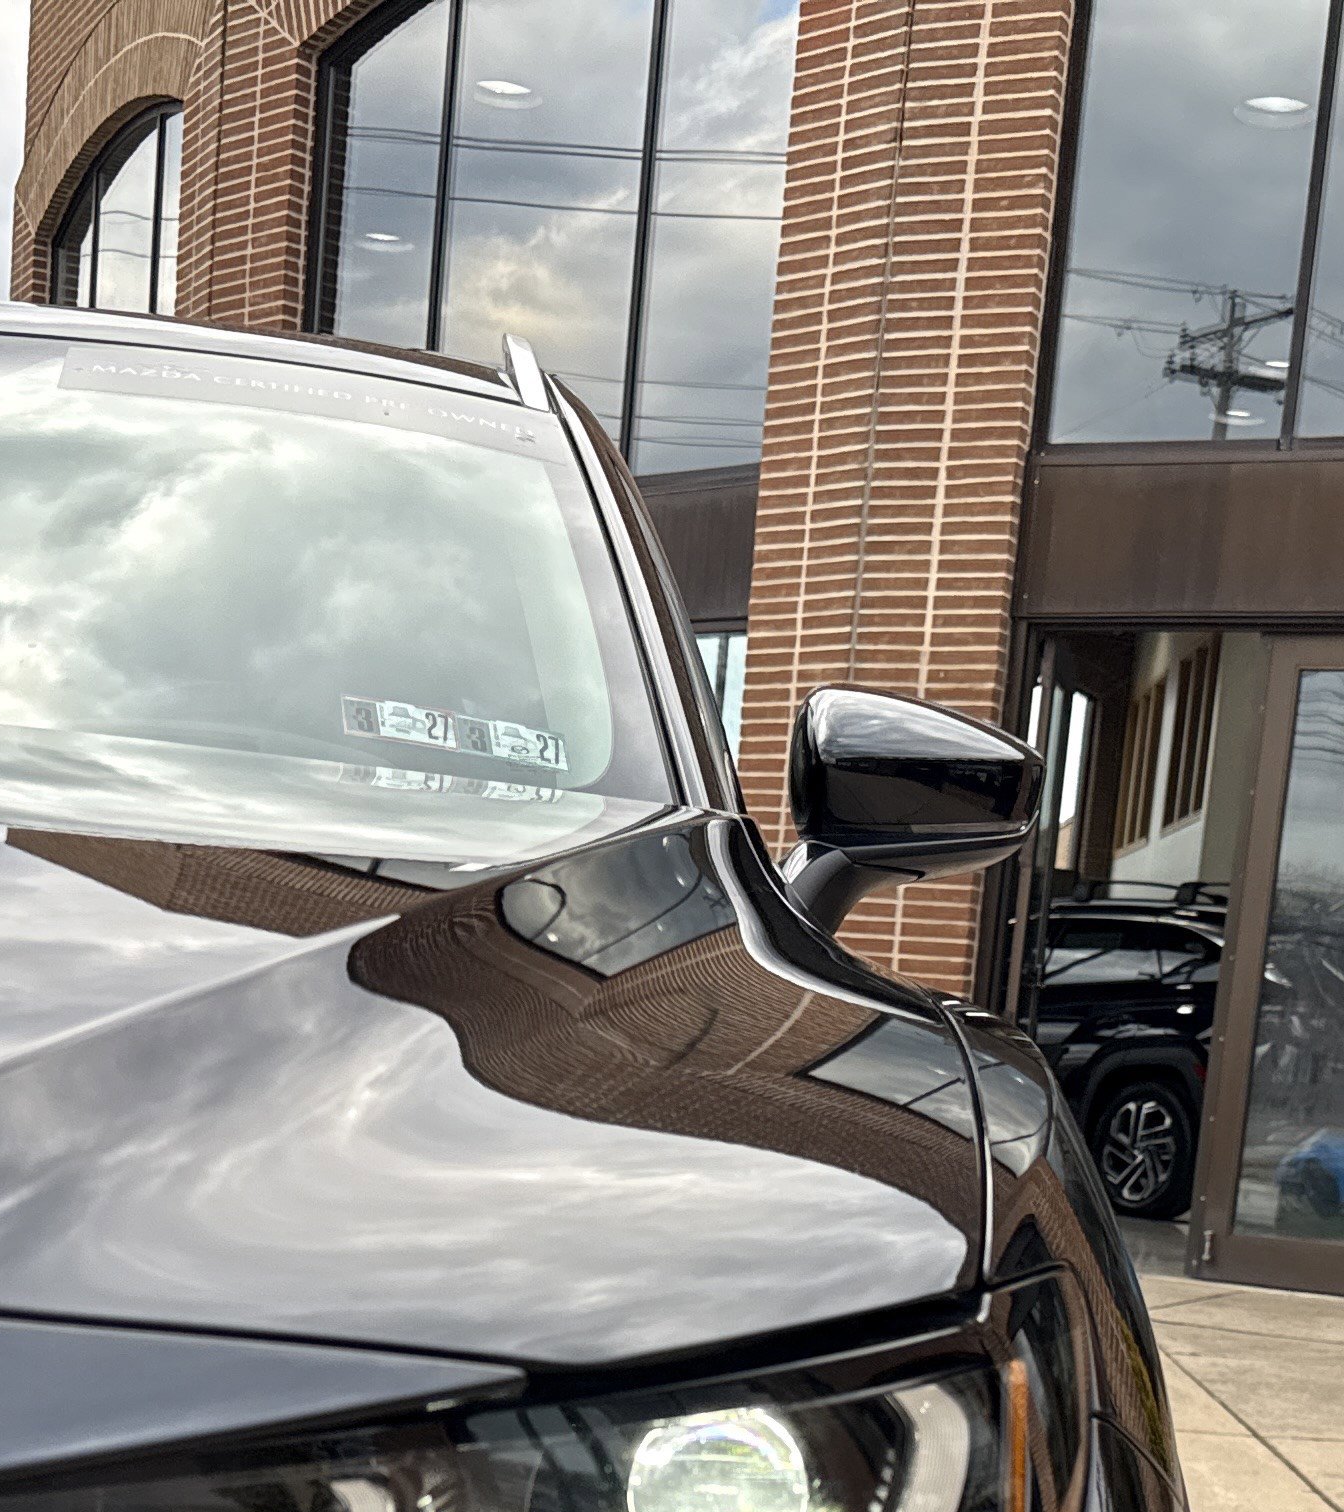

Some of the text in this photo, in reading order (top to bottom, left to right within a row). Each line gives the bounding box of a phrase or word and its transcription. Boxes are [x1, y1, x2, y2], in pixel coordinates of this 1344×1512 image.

[92, 364, 202, 382] MAZDA
[425, 712, 448, 742] 27
[535, 733, 560, 765] 27
